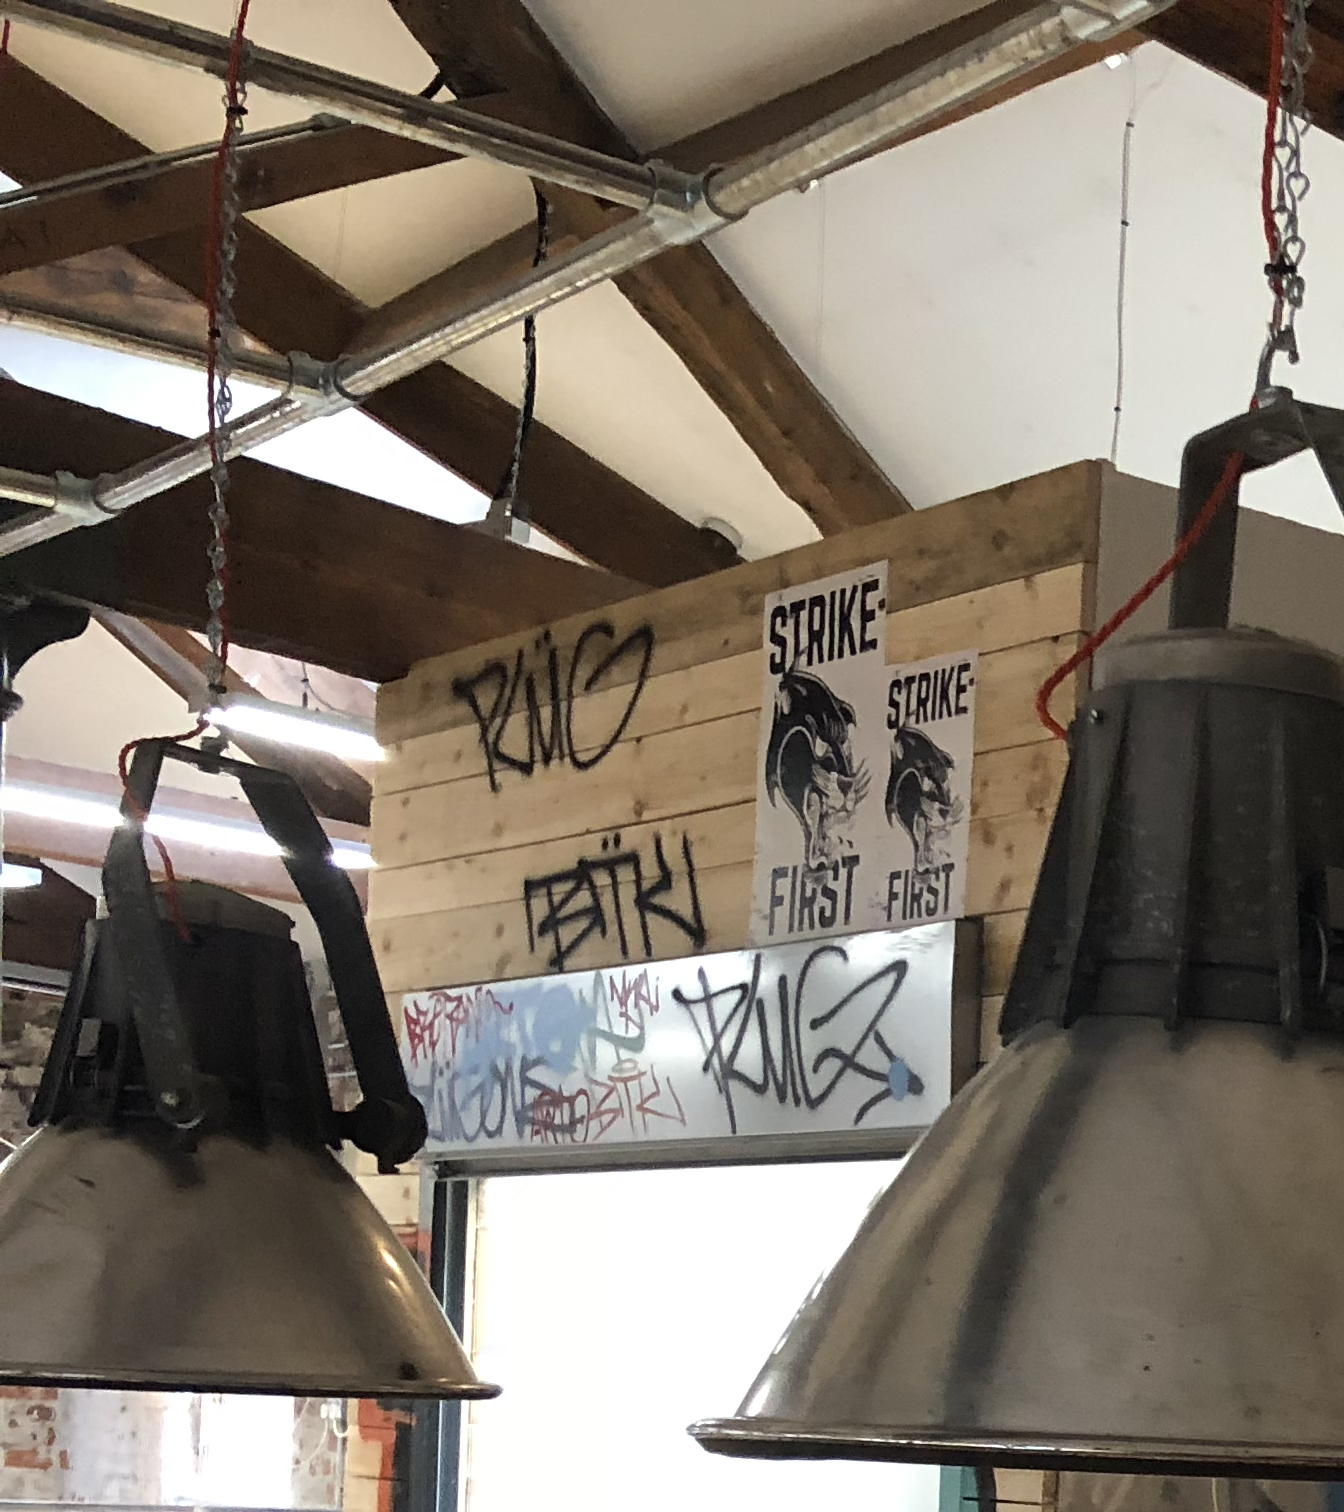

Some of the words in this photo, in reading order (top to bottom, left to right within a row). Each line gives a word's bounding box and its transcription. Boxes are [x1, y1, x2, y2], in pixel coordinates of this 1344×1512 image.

[769, 578, 881, 676] STRIKE
[887, 662, 972, 731] STRIKE
[768, 854, 861, 937] FIRST
[887, 863, 955, 923] FIRST
